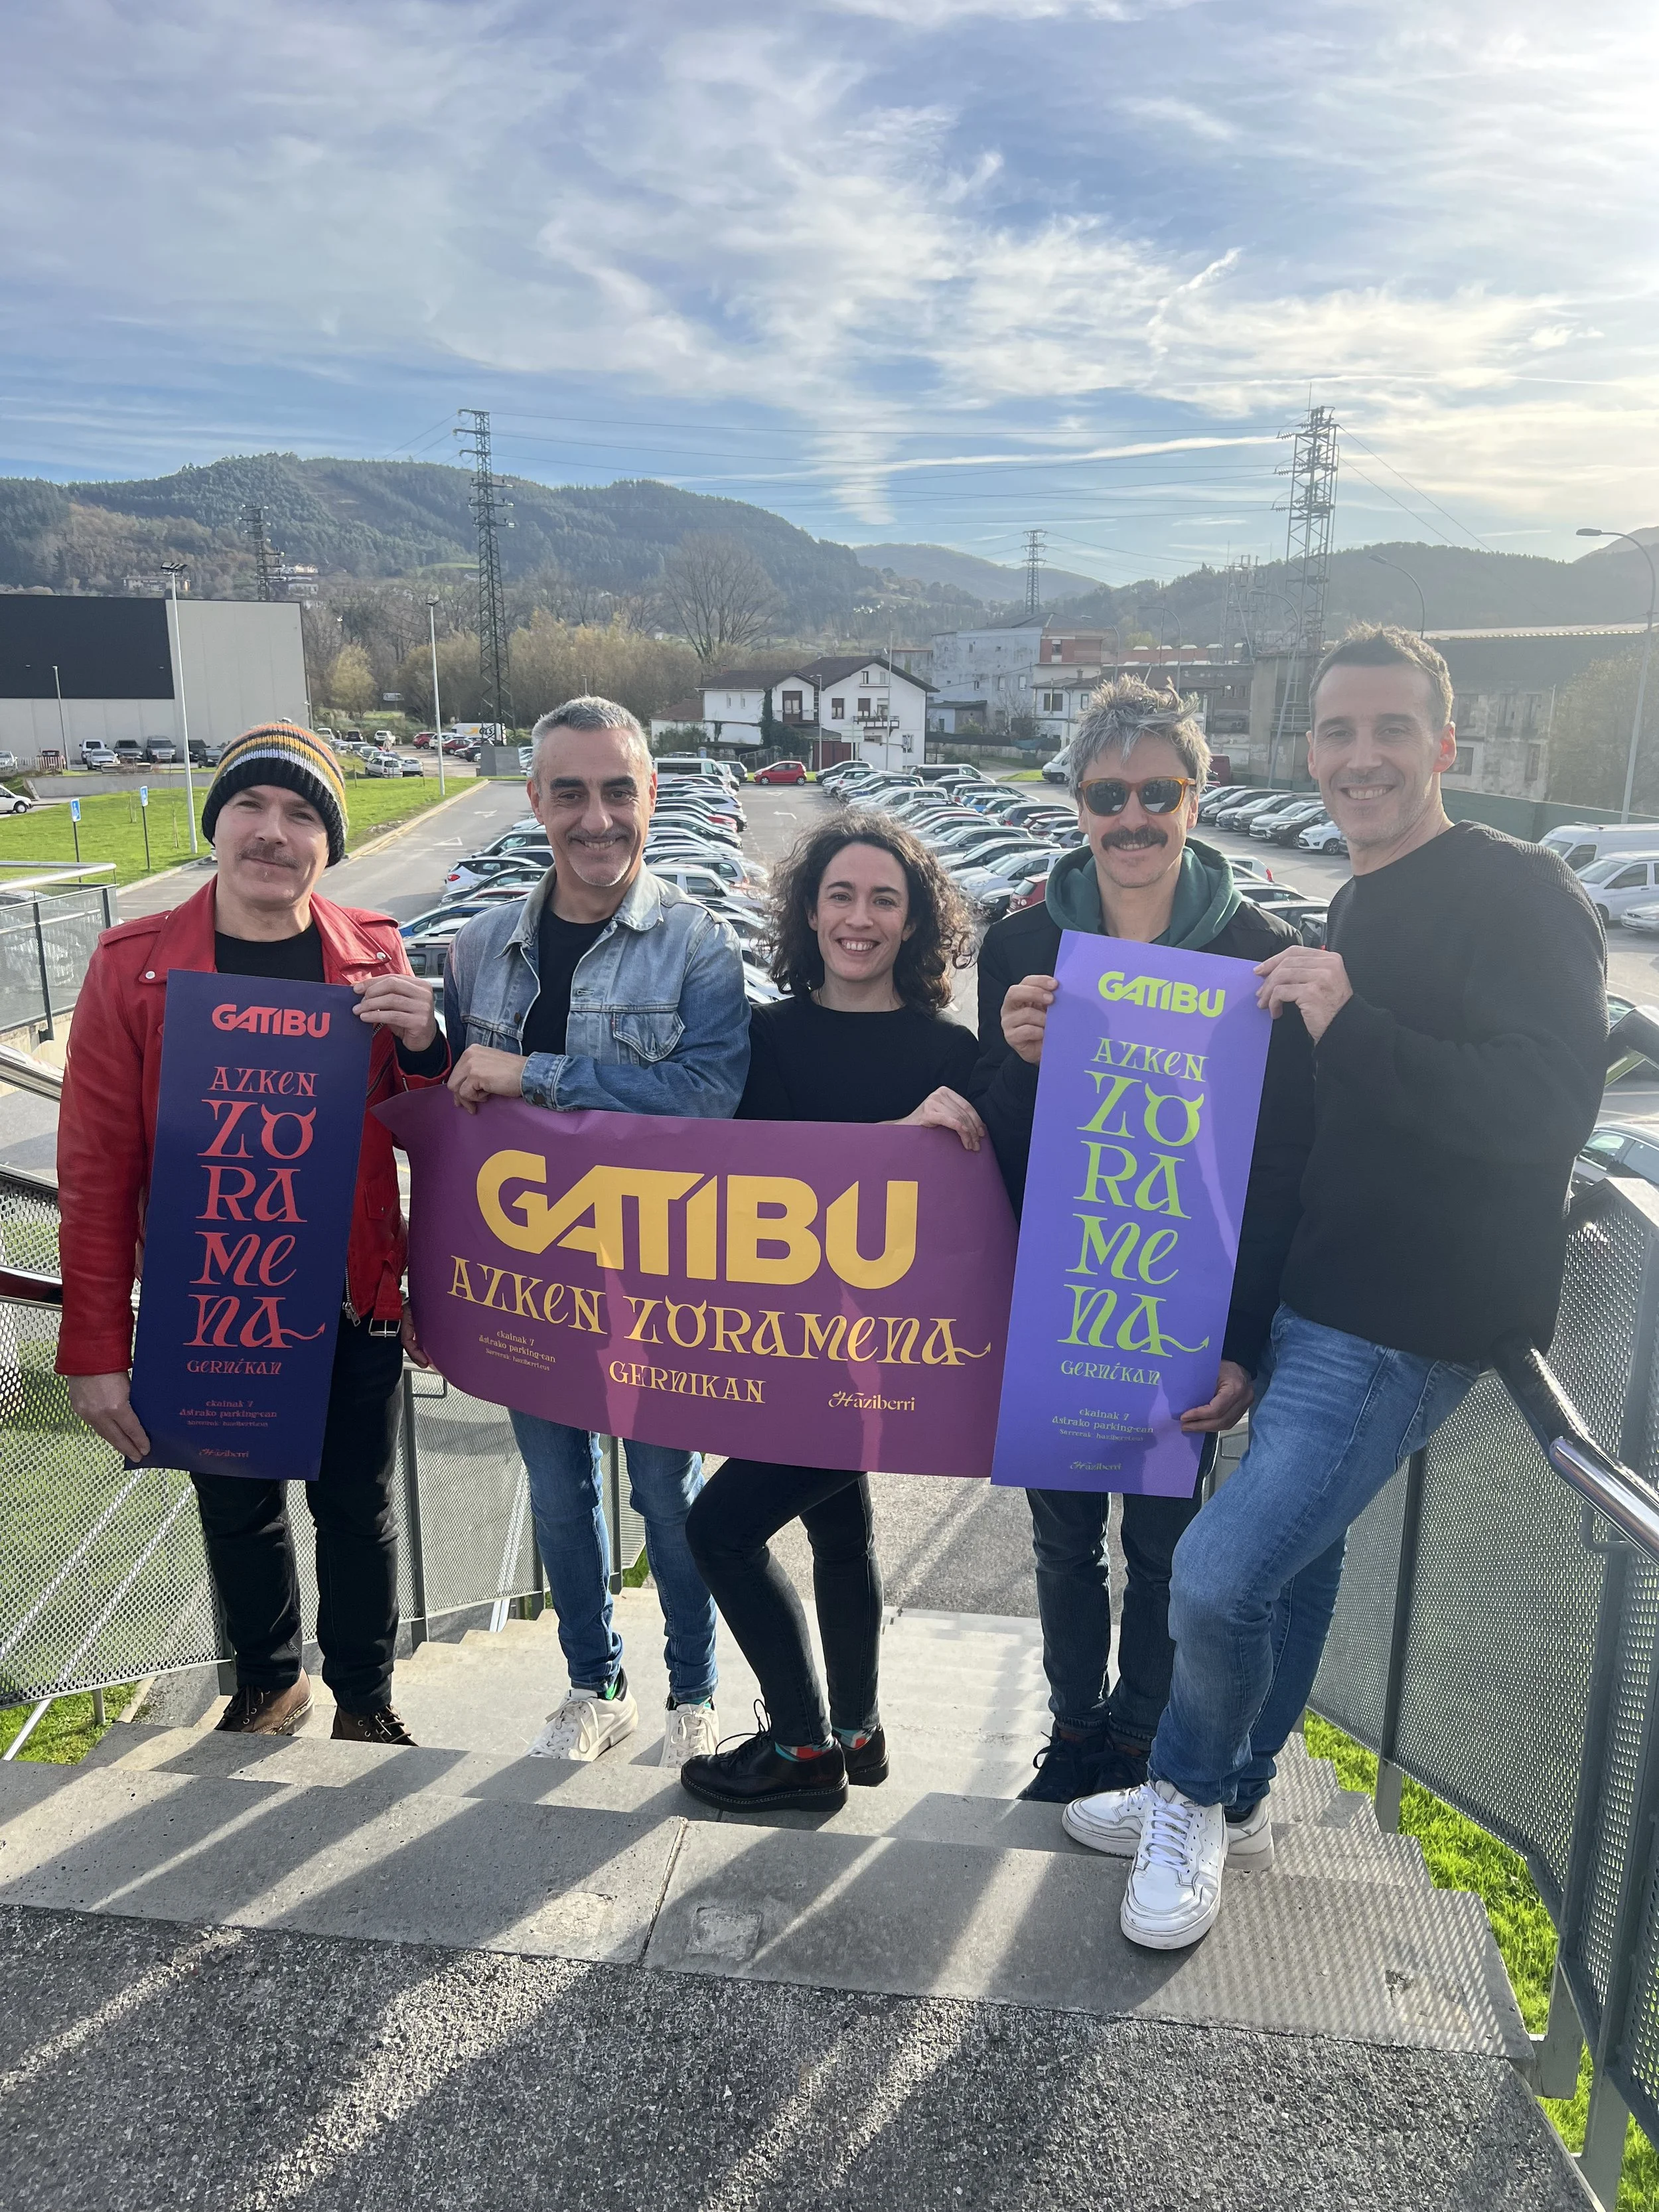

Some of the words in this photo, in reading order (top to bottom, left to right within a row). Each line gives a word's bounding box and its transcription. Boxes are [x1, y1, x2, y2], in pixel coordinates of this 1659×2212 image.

[1098, 971, 1226, 1017] GATIBU
[212, 1003, 331, 1039] GATIBU
[196, 1098, 317, 1159] ZO
[1076, 1070, 1204, 1147] ZO
[195, 1165, 308, 1222] RA
[1073, 1140, 1192, 1219] RA
[476, 1149, 919, 1289] GATIBU
[478, 1334, 507, 1349] Astrako
[496, 1330, 528, 1345] ekainak
[530, 1338, 535, 1347] 7
[609, 1360, 766, 1404] GERNIKAN
[1051, 1416, 1090, 1428] Astrako
[1079, 1408, 1119, 1420] ekainak
[1123, 1412, 1130, 1421] 7
